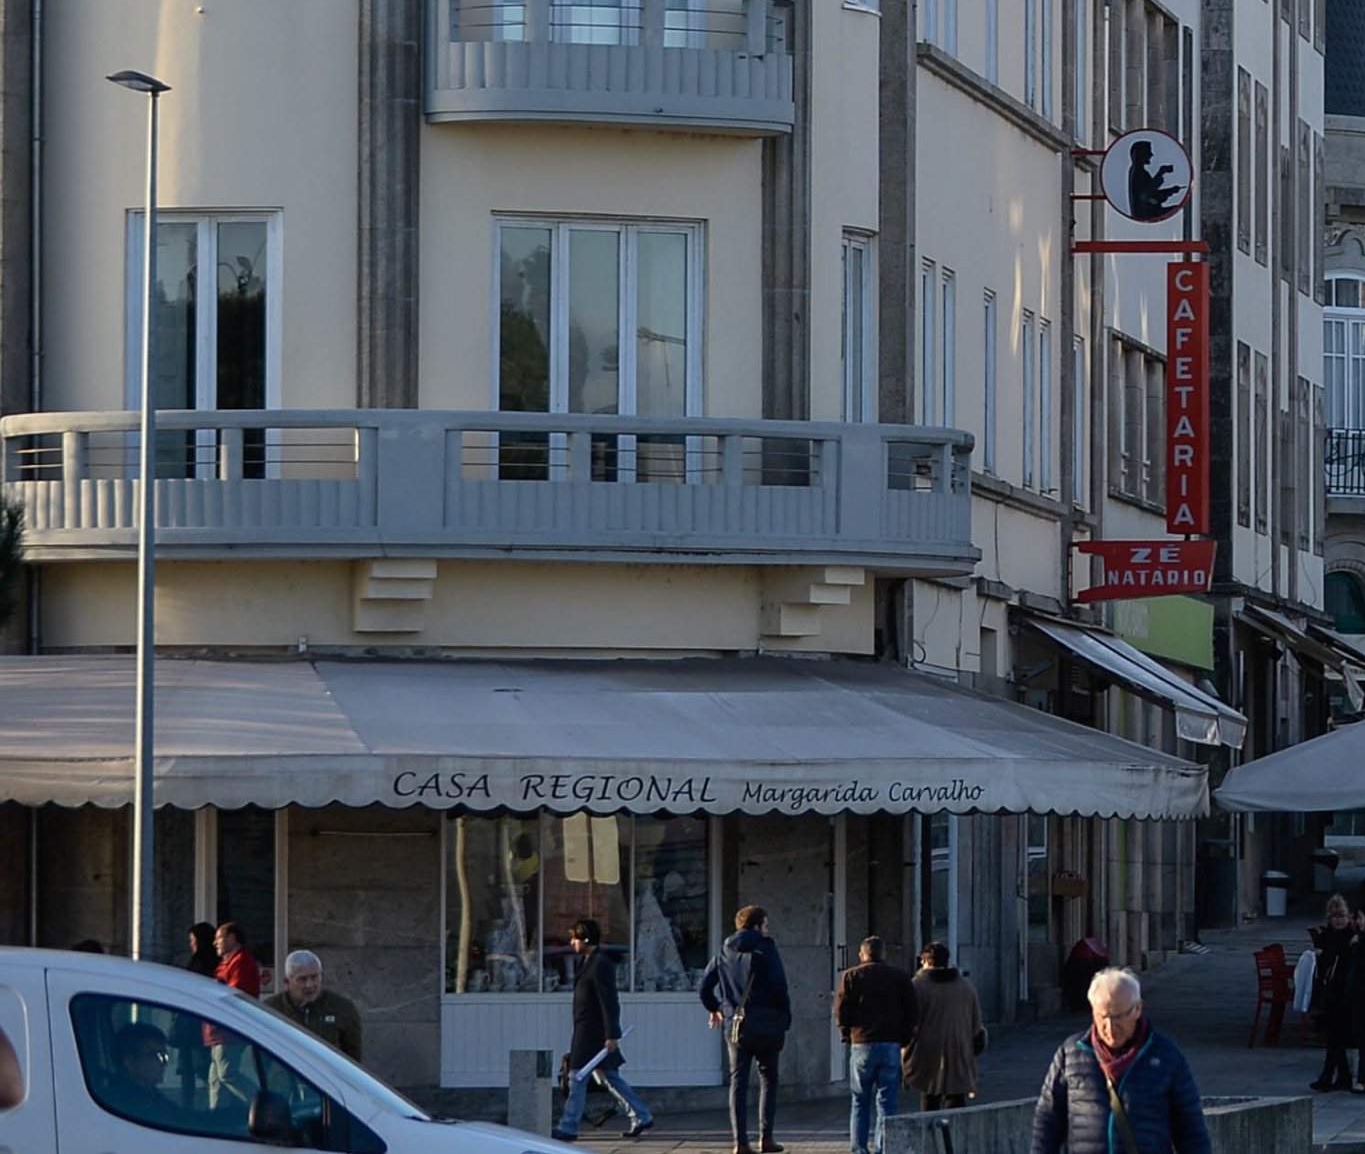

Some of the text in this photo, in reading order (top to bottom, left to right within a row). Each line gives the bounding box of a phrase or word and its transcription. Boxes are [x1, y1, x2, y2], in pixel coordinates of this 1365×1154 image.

[1172, 269, 1195, 526] CAFETARIA
[1130, 544, 1181, 563] ZÉ
[1108, 567, 1206, 585] NATÁRIO
[392, 770, 986, 810] CASA REGIONAL Margarida Carvalho
